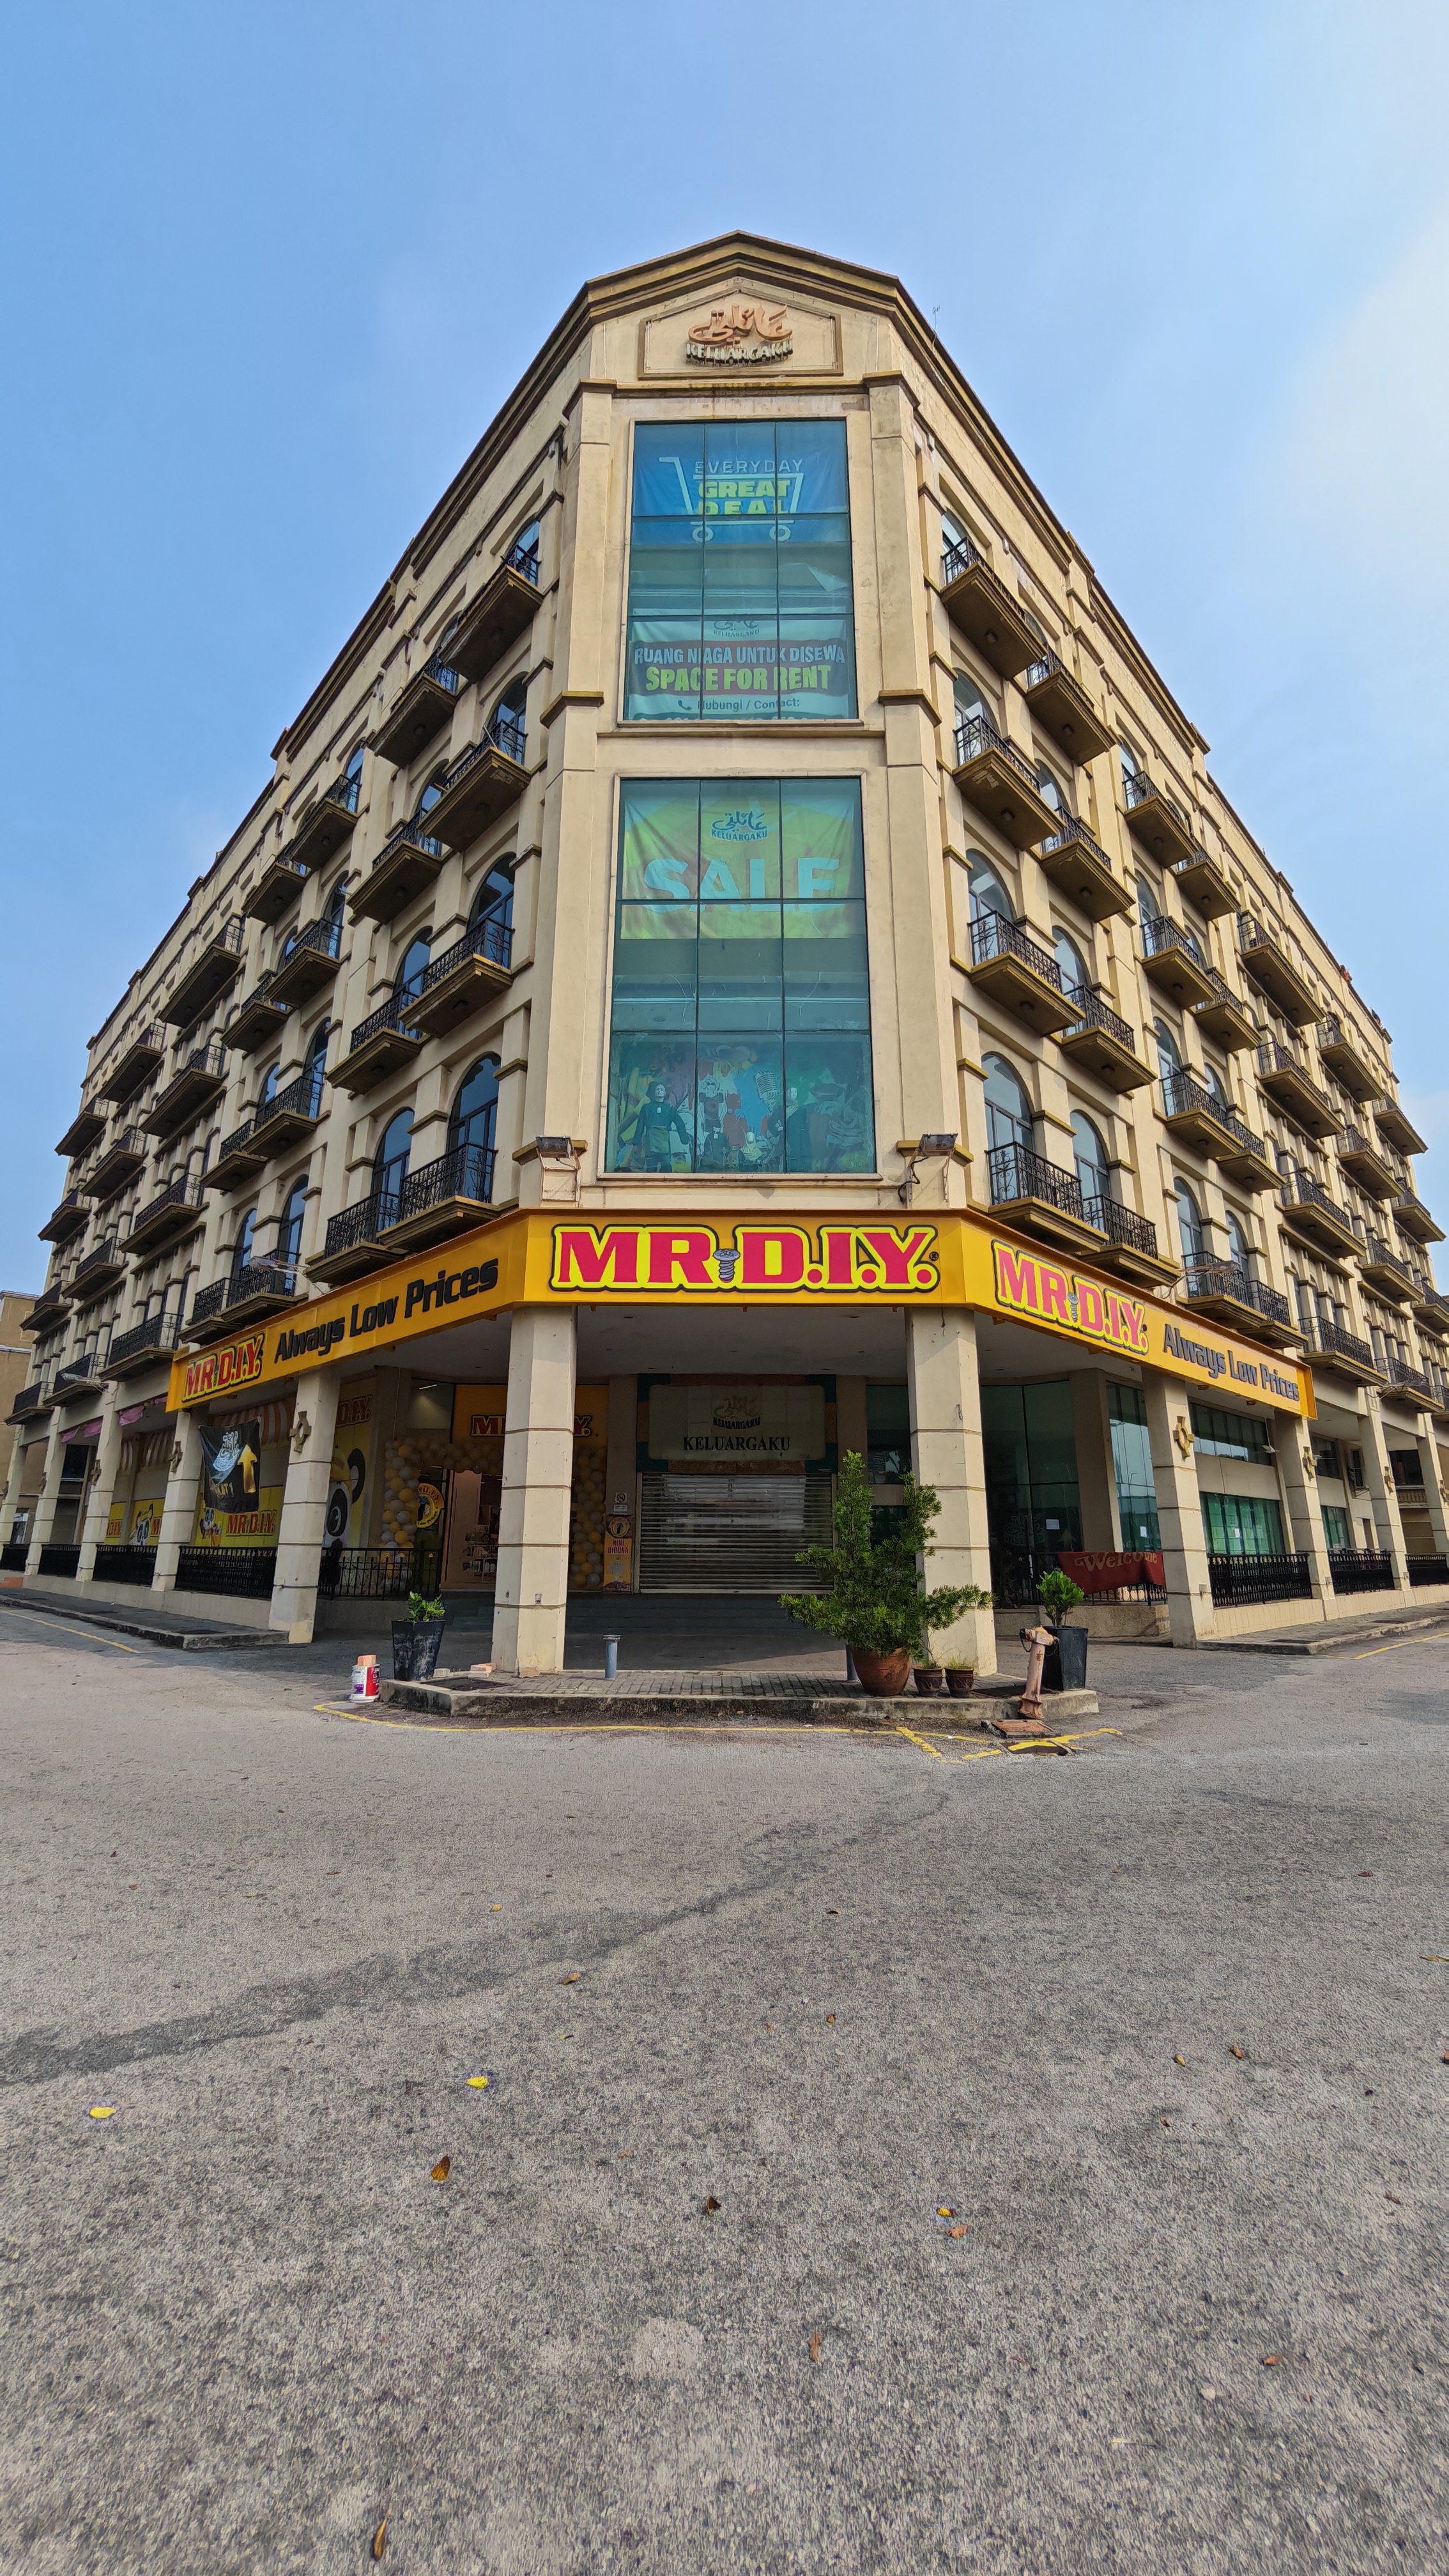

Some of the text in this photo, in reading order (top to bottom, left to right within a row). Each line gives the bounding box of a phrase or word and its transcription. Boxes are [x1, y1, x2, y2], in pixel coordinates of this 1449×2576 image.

[686, 339, 793, 365] KELUARGAKU
[694, 459, 804, 474] EVERYDAY
[698, 479, 791, 498] GREAT
[699, 500, 787, 515] DEAL
[634, 645, 845, 665] RUANG NIAGA UNTUK DISEWA
[645, 664, 831, 691] SPACE FOR RENT
[754, 697, 800, 709] Conact:
[711, 829, 768, 841] KELUARGAKU
[641, 857, 839, 914] SALE
[274, 1257, 499, 1363] Always Low Prices
[1163, 1323, 1300, 1402] Always Low Prices
[713, 1416, 761, 1430] KELUARGAKU
[682, 1436, 791, 1451] KELUARGAKU
[1074, 1552, 1158, 1572] Welcome
